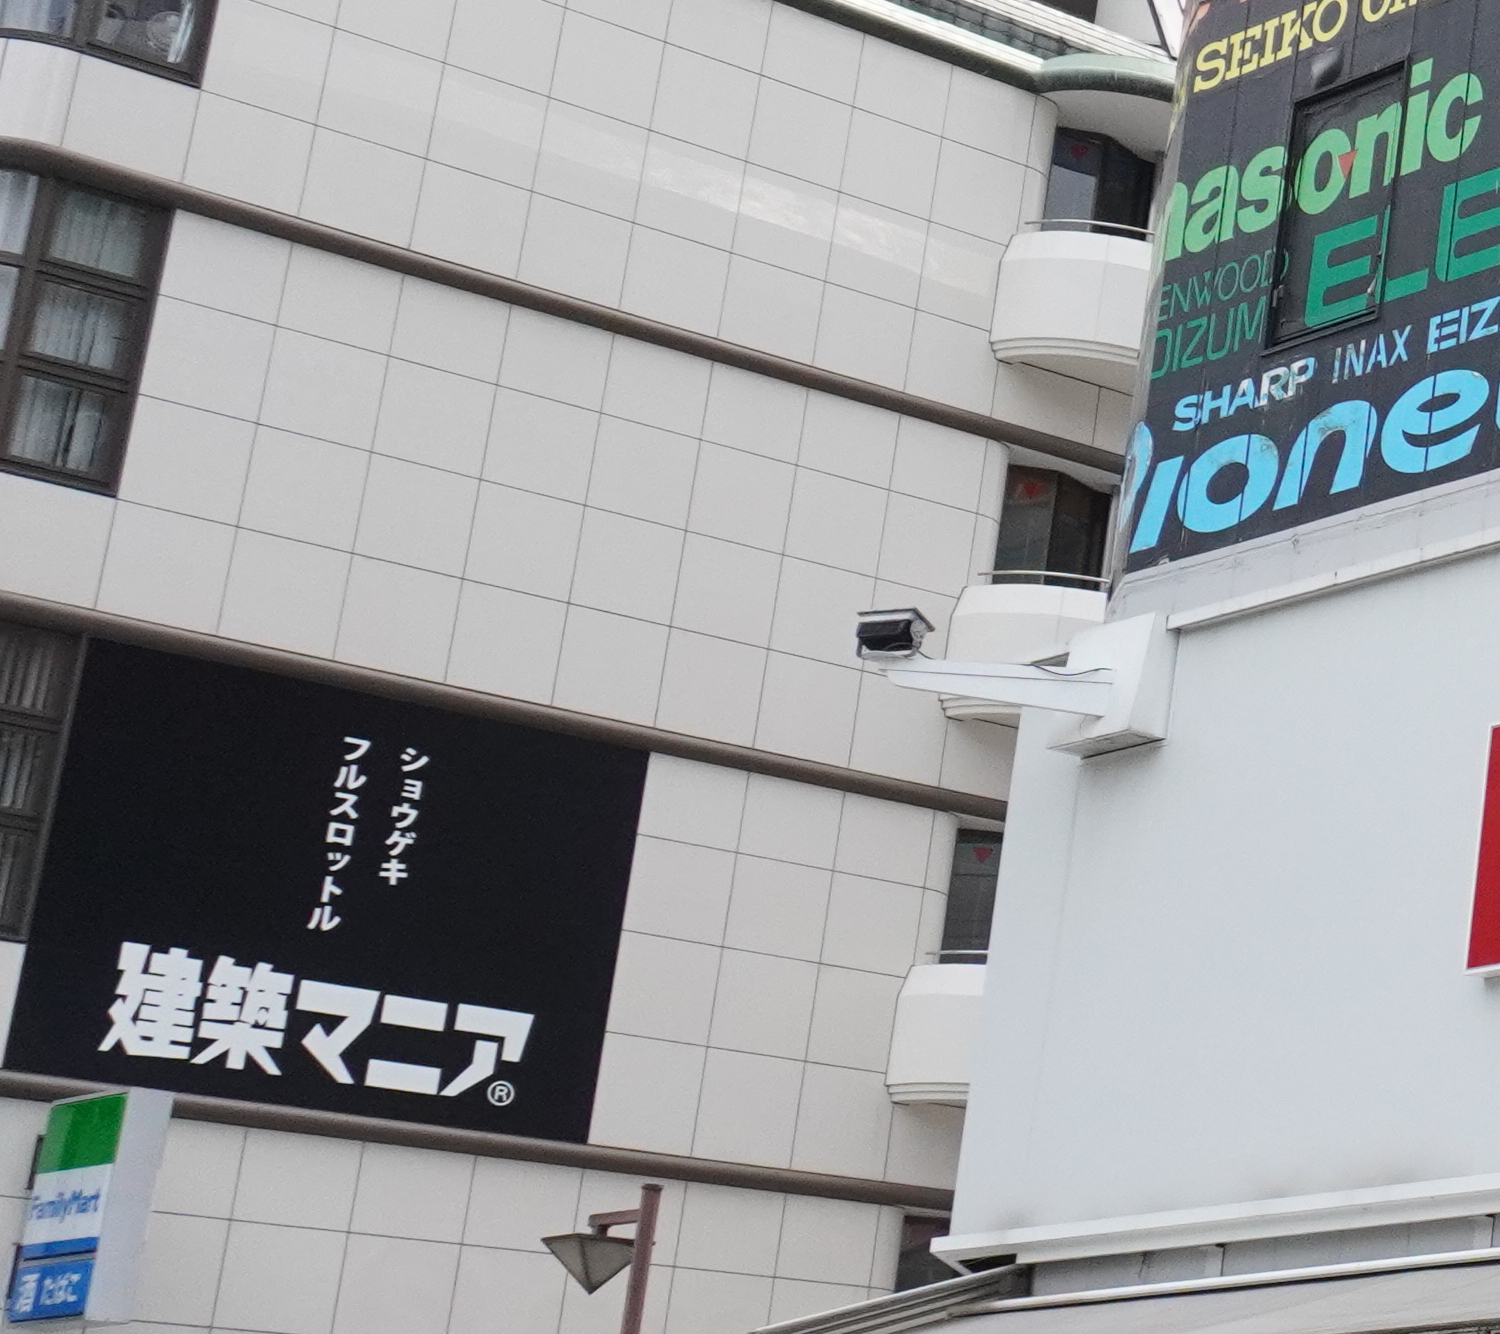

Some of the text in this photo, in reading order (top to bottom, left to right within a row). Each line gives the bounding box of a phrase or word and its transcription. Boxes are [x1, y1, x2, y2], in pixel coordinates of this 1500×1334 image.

[1171, 356, 1313, 430] SHARP
[1332, 325, 1412, 384] INAX
[307, 736, 371, 932] フルスロットル
[379, 747, 431, 885] ショウゲキ
[98, 941, 535, 1097] 建築マニア
